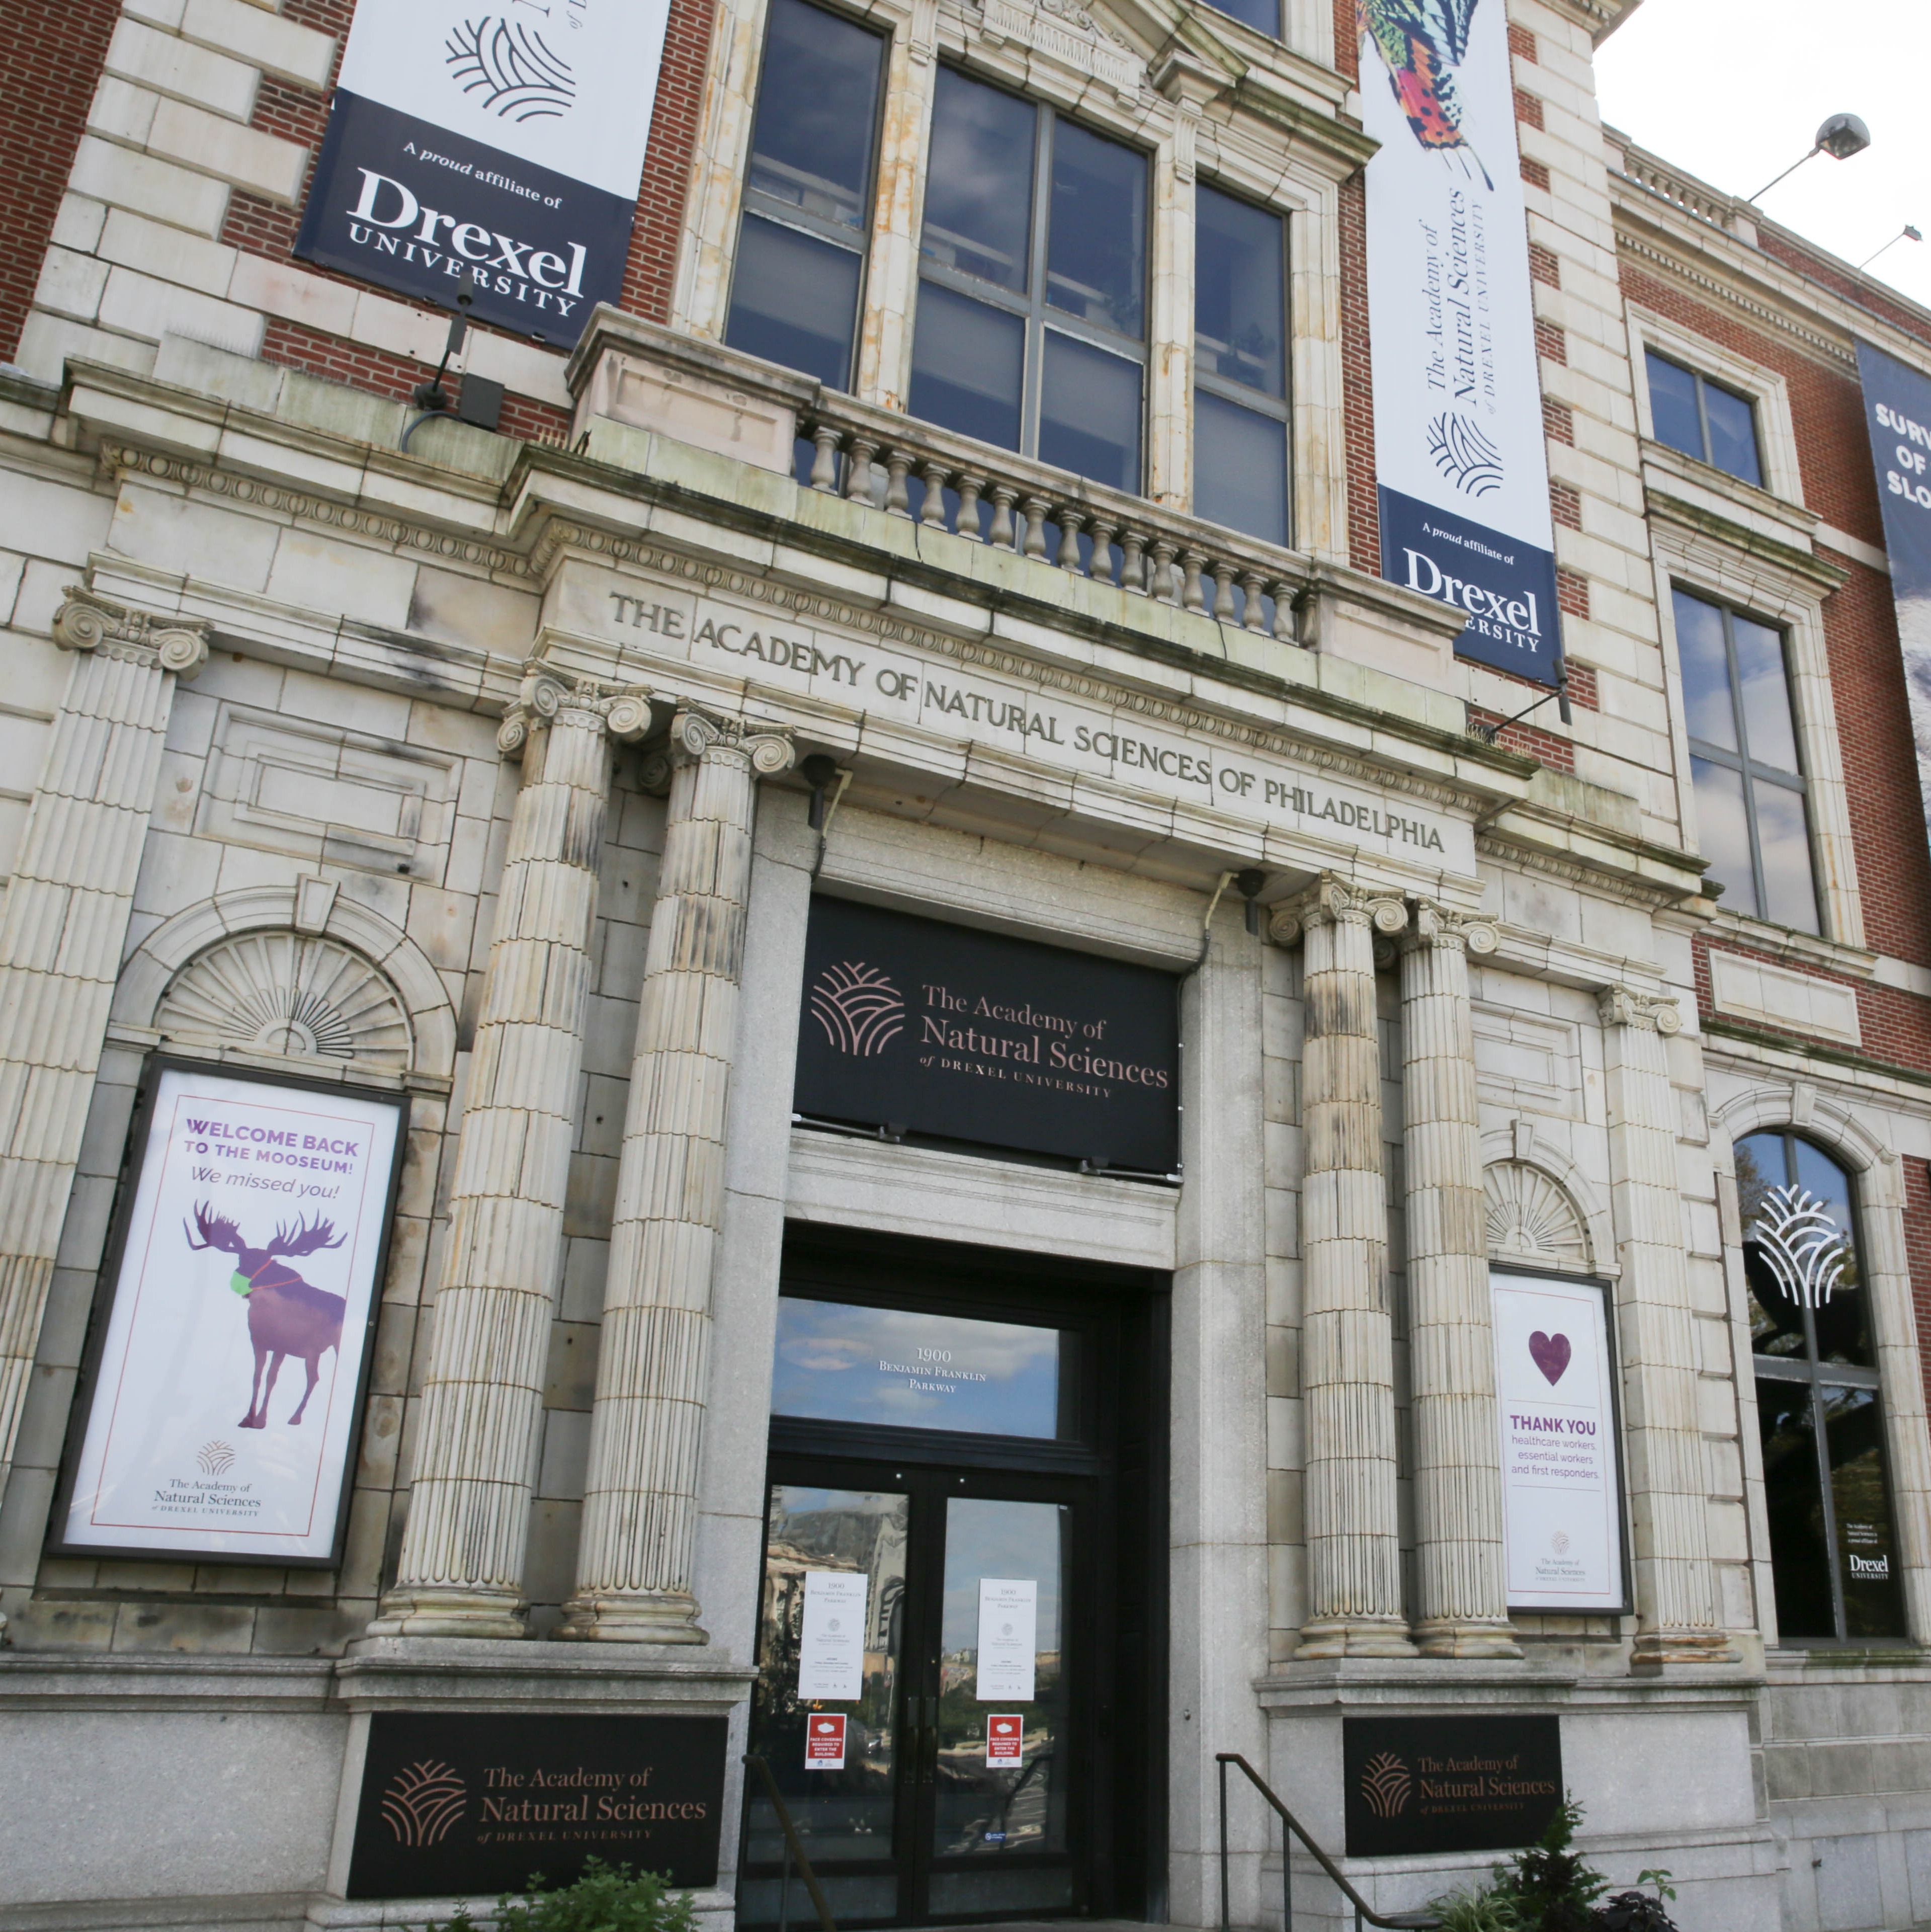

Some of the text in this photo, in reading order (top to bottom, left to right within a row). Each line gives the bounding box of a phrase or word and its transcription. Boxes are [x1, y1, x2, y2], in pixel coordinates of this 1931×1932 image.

[403, 141, 562, 209] A proud affiliate of
[346, 168, 586, 298] Drexel
[349, 222, 576, 316] UNIVERSITY
[1472, 199, 1489, 312] UNIVERSITY
[1419, 219, 1445, 390] The Academy of
[1446, 188, 1476, 406] Natural Sciences
[1479, 322, 1495, 396] DREXEL
[1896, 445, 1925, 475] OF
[1887, 470, 1931, 509] SLO
[1423, 523, 1514, 565] A proud affiliate of
[1403, 547, 1542, 636] Drexel
[1465, 616, 1539, 652] ERSITY
[609, 592, 1445, 853] THE ACADEMY OF NATURAL SCIENCES OF PHILADELPHIA
[922, 984, 1106, 1040] The Academy of
[920, 1015, 1168, 1088] Natural Sciences
[920, 1056, 1111, 1098] of DREXEL UNIVERSITY
[186, 1118, 359, 1157] WELCOME BACK
[184, 1141, 353, 1174] TO THE MOOSEUM!
[192, 1166, 340, 1199] We missed you!
[916, 1347, 951, 1362] 1900
[1510, 1415, 1595, 1435] THANK YOU
[1512, 1435, 1560, 1447] healthcare
[1512, 1465, 1529, 1474] and
[1532, 1465, 1549, 1475] first
[1518, 1452, 1593, 1464] essential workers
[154, 1490, 261, 1507] Natural Sciences
[170, 1478, 253, 1493] The Academy of
[161, 1505, 197, 1513] DREXEL
[202, 1507, 259, 1516] UNIVERSITY
[1849, 1555, 1889, 1572] Drexel
[484, 1767, 653, 1792] The Academy of
[1418, 1754, 1519, 1774] The Academy of
[1419, 1777, 1555, 1799] Natural Sciences
[479, 1795, 706, 1822] Natural Sciences
[1432, 1805, 1468, 1813] DREXEL
[1471, 1803, 1525, 1811] UNIVERSITY
[477, 1829, 652, 1844] of DREXEL UNIVERSITY
